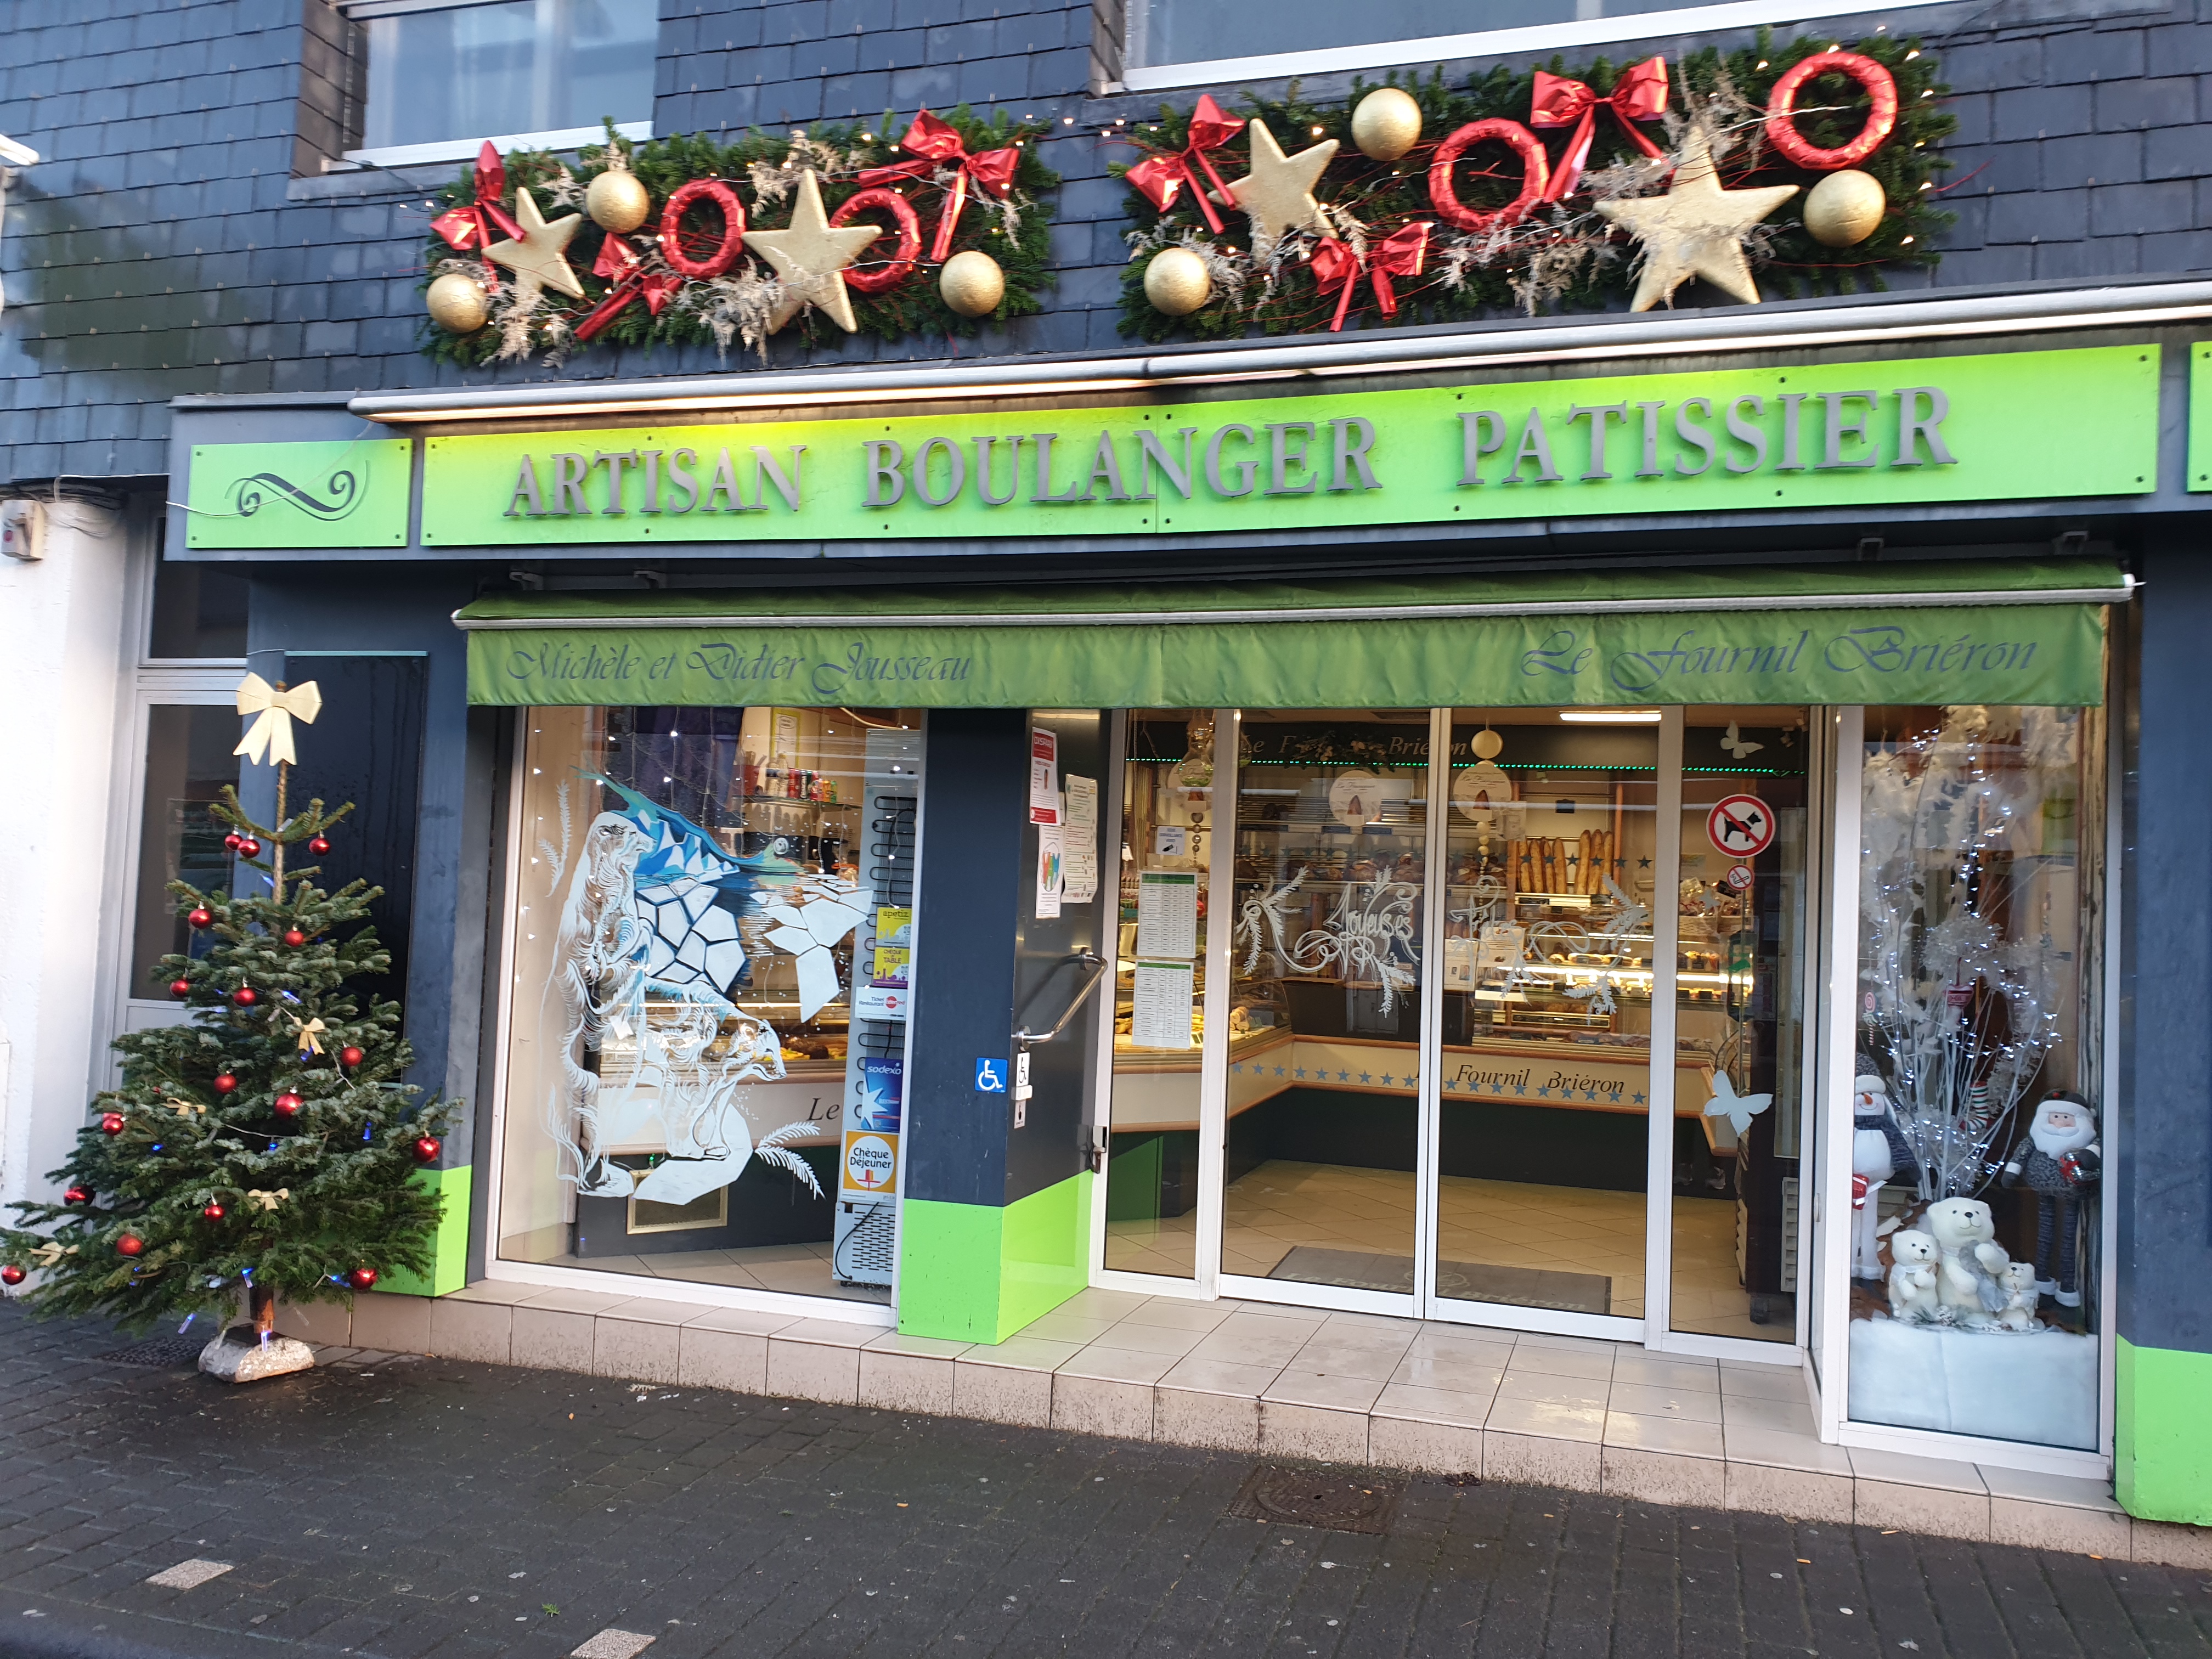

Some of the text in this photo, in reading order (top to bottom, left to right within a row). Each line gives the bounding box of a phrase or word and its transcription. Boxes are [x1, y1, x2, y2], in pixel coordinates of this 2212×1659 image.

[503, 386, 1958, 517] ARTISAN BOULANGER PATISSIER
[506, 641, 973, 695] Michèle et Didier Jousseau
[1521, 625, 2038, 691] Le Fournil Briéron
[883, 910, 909, 918] apetiz
[867, 1065, 902, 1075] sodexo
[1455, 1064, 1625, 1093] Fournil Briéron
[806, 1098, 840, 1121] Le
[850, 1156, 892, 1169] Déjeuner
[854, 1147, 889, 1160] Chèque
